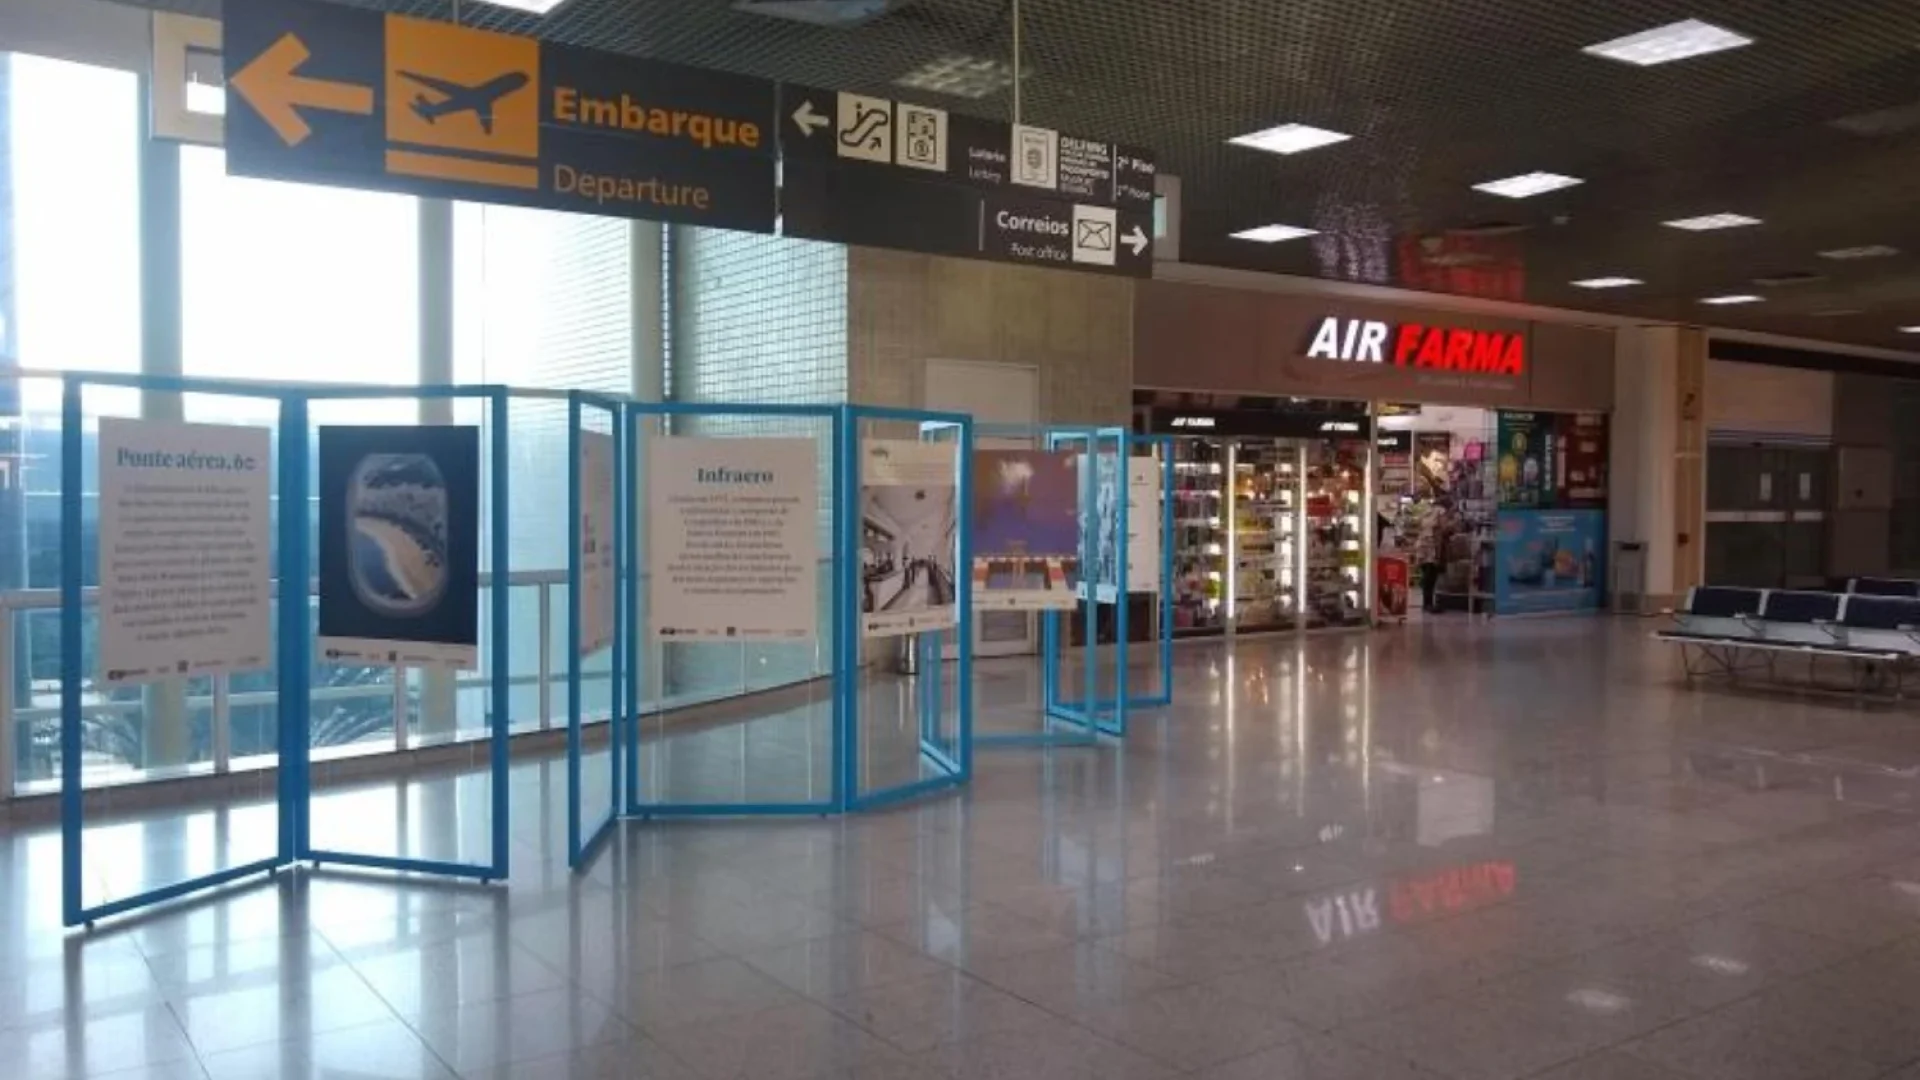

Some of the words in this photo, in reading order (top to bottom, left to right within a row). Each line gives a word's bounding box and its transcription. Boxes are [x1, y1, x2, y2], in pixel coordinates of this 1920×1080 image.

[553, 86, 760, 148] Embarque
[553, 164, 710, 209] Departure
[996, 210, 1070, 236] Correios
[1307, 317, 1387, 361] AIR
[1394, 324, 1523, 375] FARMA
[117, 447, 174, 469] Ponte
[697, 467, 774, 484] Infraero
